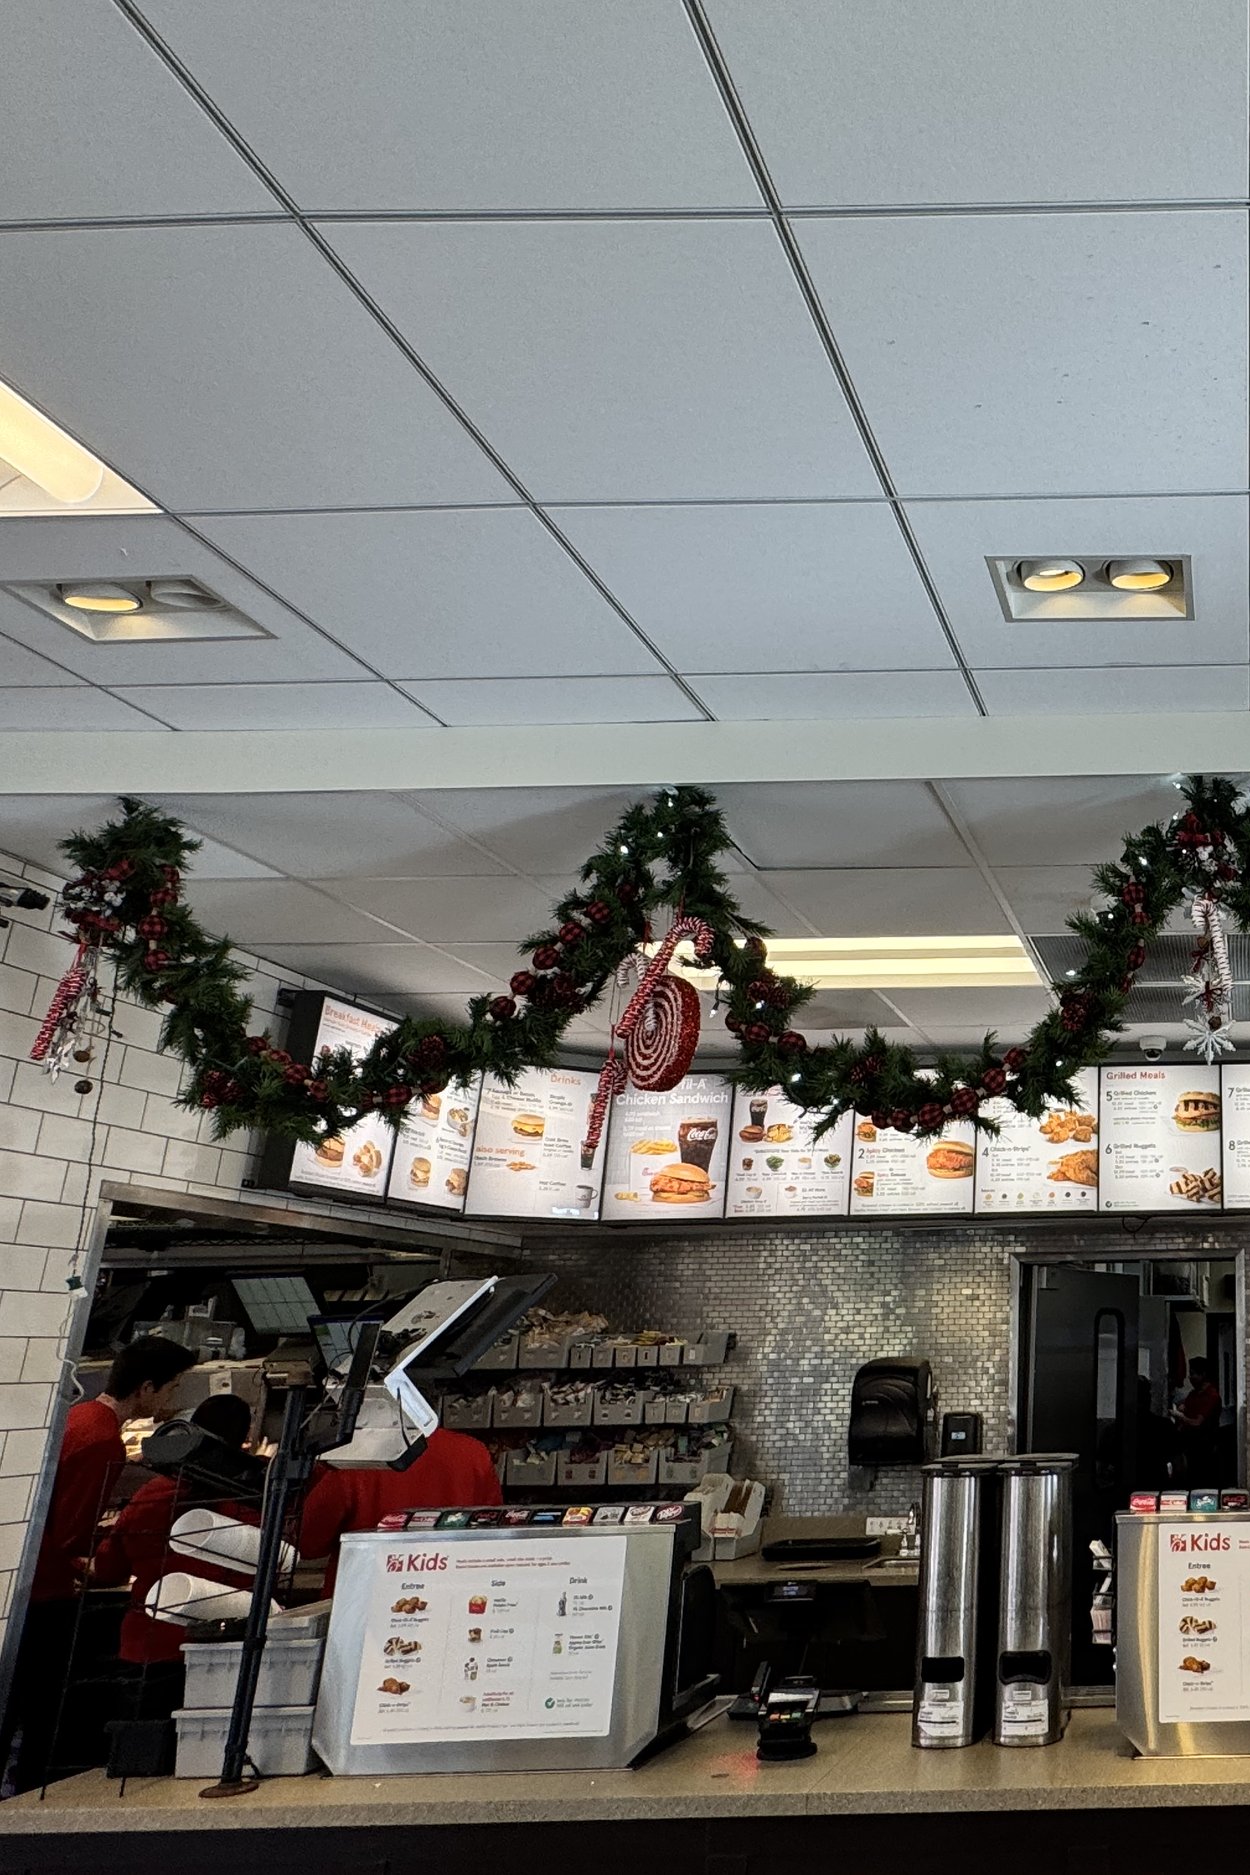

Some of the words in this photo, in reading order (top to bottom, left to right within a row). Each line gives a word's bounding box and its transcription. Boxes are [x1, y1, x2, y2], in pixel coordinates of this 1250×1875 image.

[550, 1073, 582, 1086] Drinks
[1106, 1071, 1137, 1080] Grilled
[1140, 1071, 1166, 1079] Meals
[1106, 1090, 1113, 1102] 5
[1227, 1087, 1235, 1098] 7
[616, 1093, 666, 1106] Chicken
[669, 1092, 729, 1105] Sandwich
[1105, 1144, 1113, 1155] 6
[1228, 1140, 1236, 1151] 8
[476, 1146, 494, 1155] also
[495, 1148, 526, 1157] serving
[858, 1148, 865, 1159] 2
[981, 1147, 989, 1158] 4
[1190, 1533, 1231, 1552] Kids
[407, 1553, 448, 1572] Kids
[1188, 1562, 1211, 1570] Entree
[569, 1577, 588, 1585] Drink
